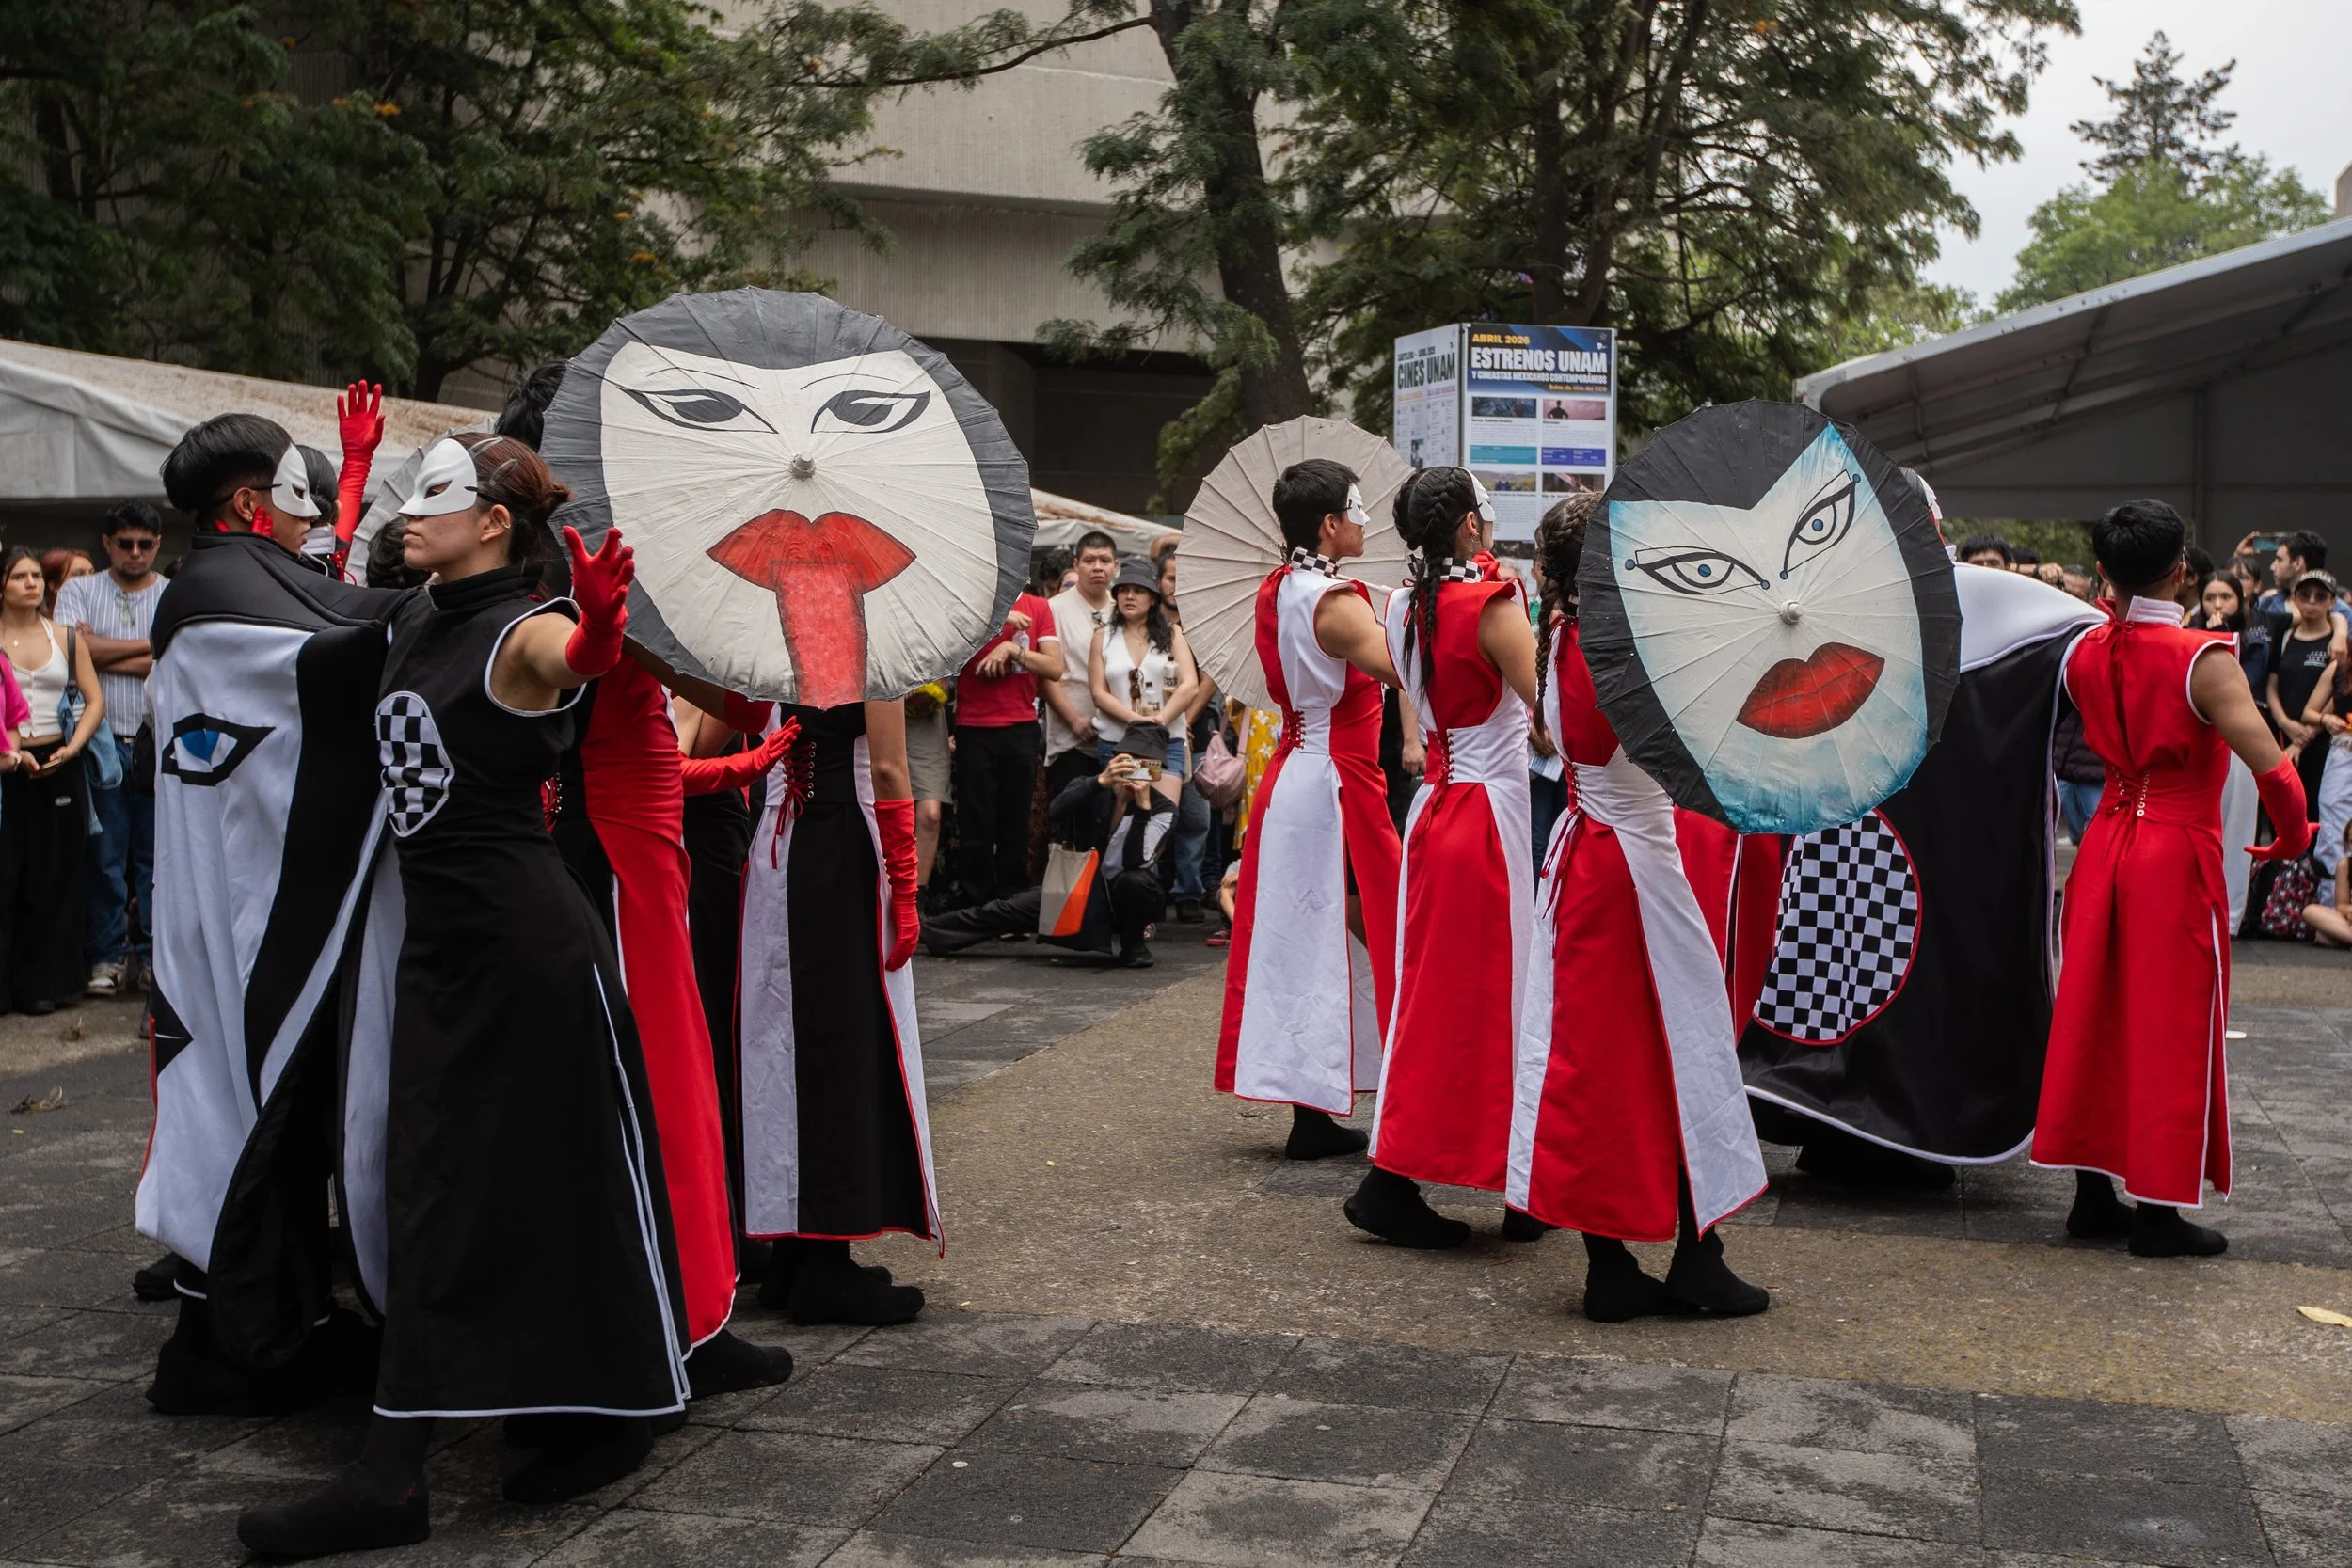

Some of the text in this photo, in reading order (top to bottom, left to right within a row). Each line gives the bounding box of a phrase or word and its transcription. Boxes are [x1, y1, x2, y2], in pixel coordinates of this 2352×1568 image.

[1472, 333, 1530, 345] ABRIL 2026
[1470, 346, 1608, 373] ESTRENOS UNAM
[1397, 353, 1455, 390] CINES UNAM
[1470, 370, 1477, 380] Y
